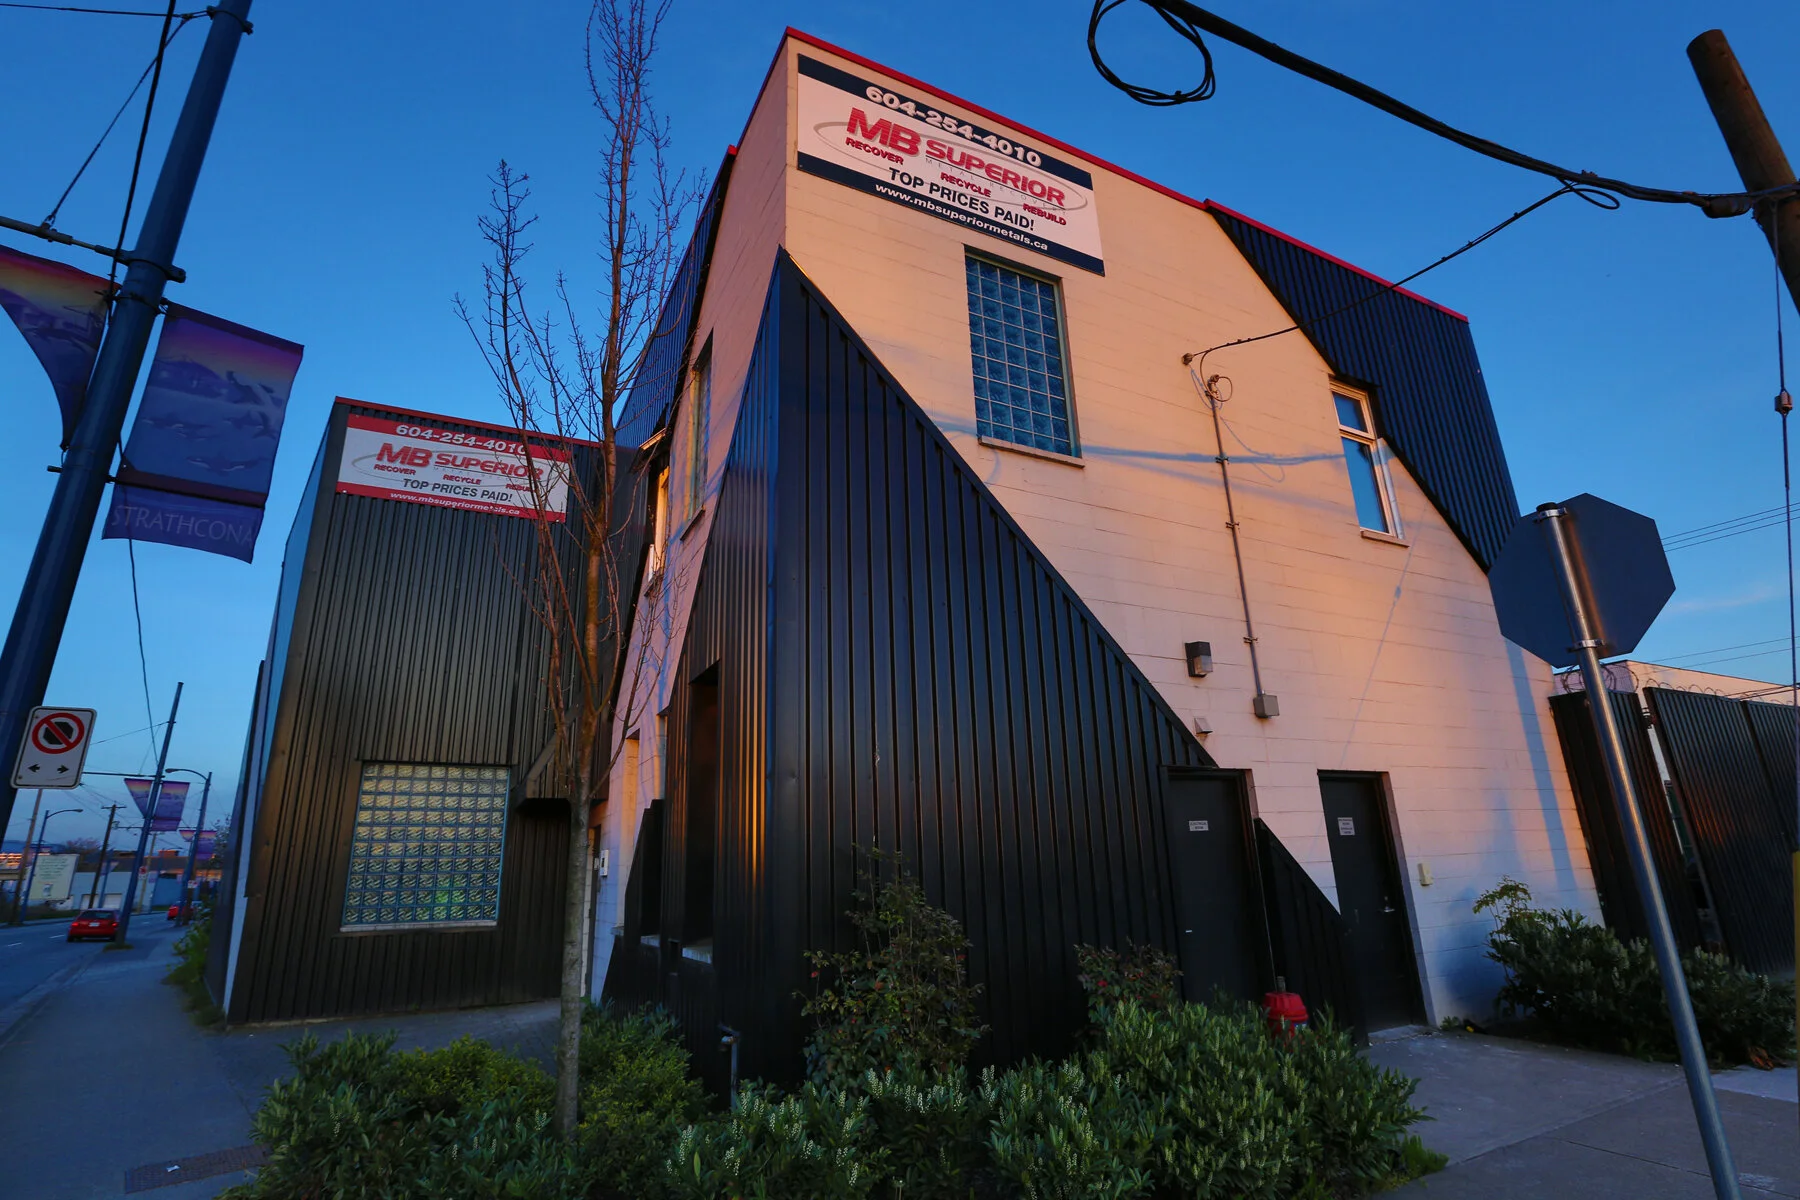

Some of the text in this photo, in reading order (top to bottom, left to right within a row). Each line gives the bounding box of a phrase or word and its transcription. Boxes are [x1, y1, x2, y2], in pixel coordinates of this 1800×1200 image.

[866, 86, 1042, 168] 604-254-4010
[845, 137, 904, 165] RECOVER
[847, 107, 1066, 207] MB SUPERIOR
[940, 171, 992, 198] RECYCLE
[889, 167, 1036, 231] TOP PRICES PAID!
[875, 184, 1049, 251] www.mbsuperiormetals.ca
[1022, 203, 1067, 226] REBUILD
[376, 442, 433, 468] MB
[374, 463, 417, 476] RECOVER
[443, 474, 482, 486] RECYCLE
[402, 478, 514, 503] TOP PRICES PAID!
